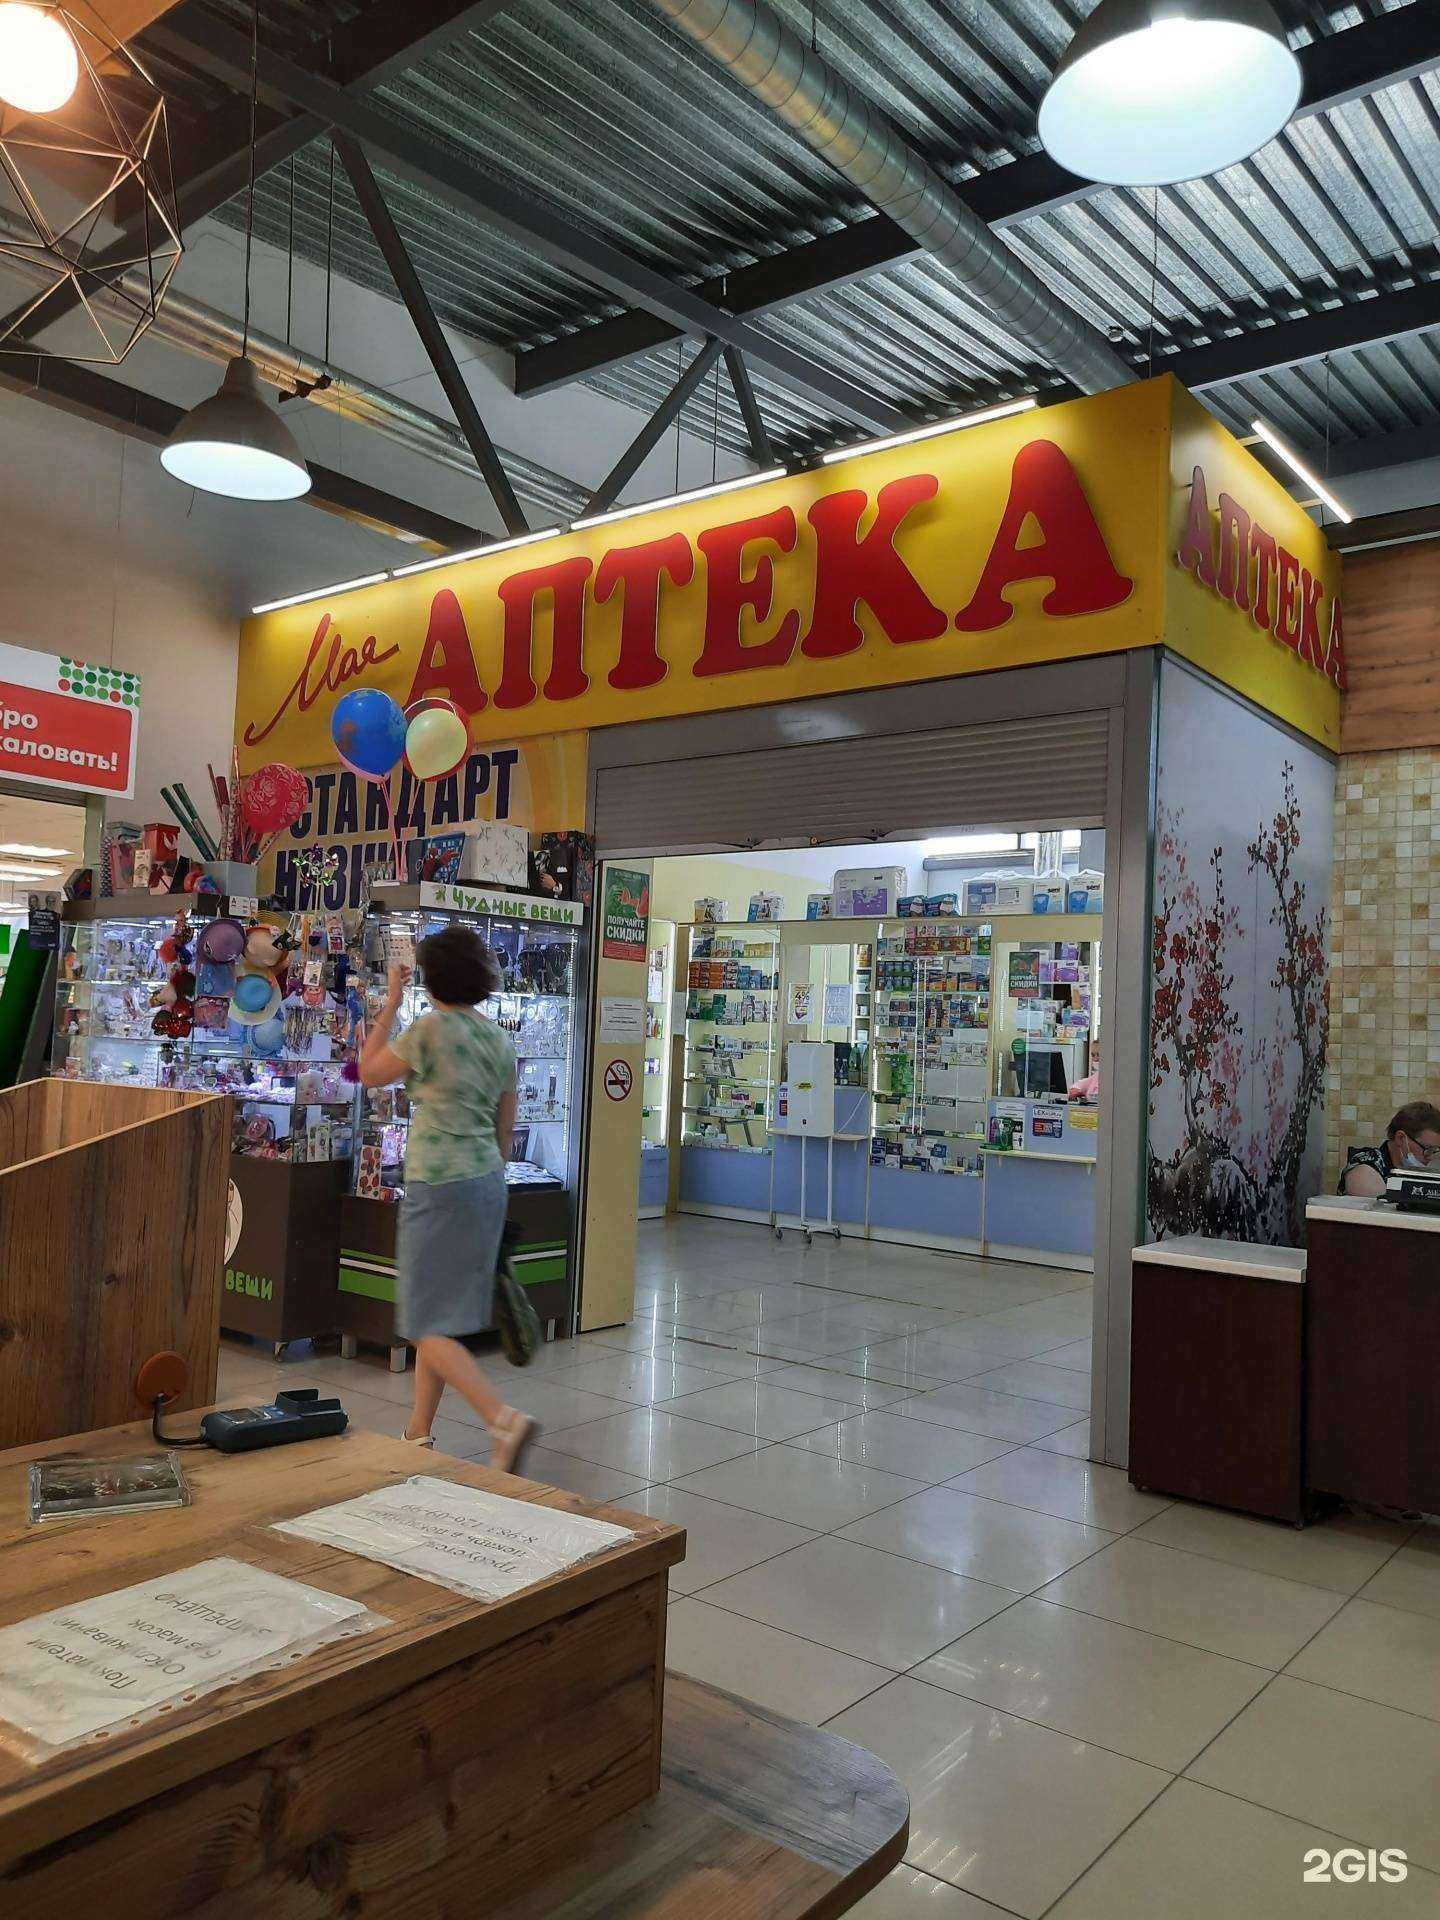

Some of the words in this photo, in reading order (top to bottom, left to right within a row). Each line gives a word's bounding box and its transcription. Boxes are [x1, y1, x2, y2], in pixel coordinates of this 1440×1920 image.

[403, 439, 1134, 715] АПТЕКА
[1177, 465, 1347, 690] АПТЕКА
[452, 887, 527, 917] ЧУДНЫЕ
[530, 904, 574, 923] ВЕЩИ
[607, 915, 645, 928] ПОЛУЧАЙТЕ
[607, 926, 645, 942] СКИДКИ
[225, 1269, 273, 1301] ВЕЩИ
[154, 1592, 272, 1634] ЗПРЕЩЕНО
